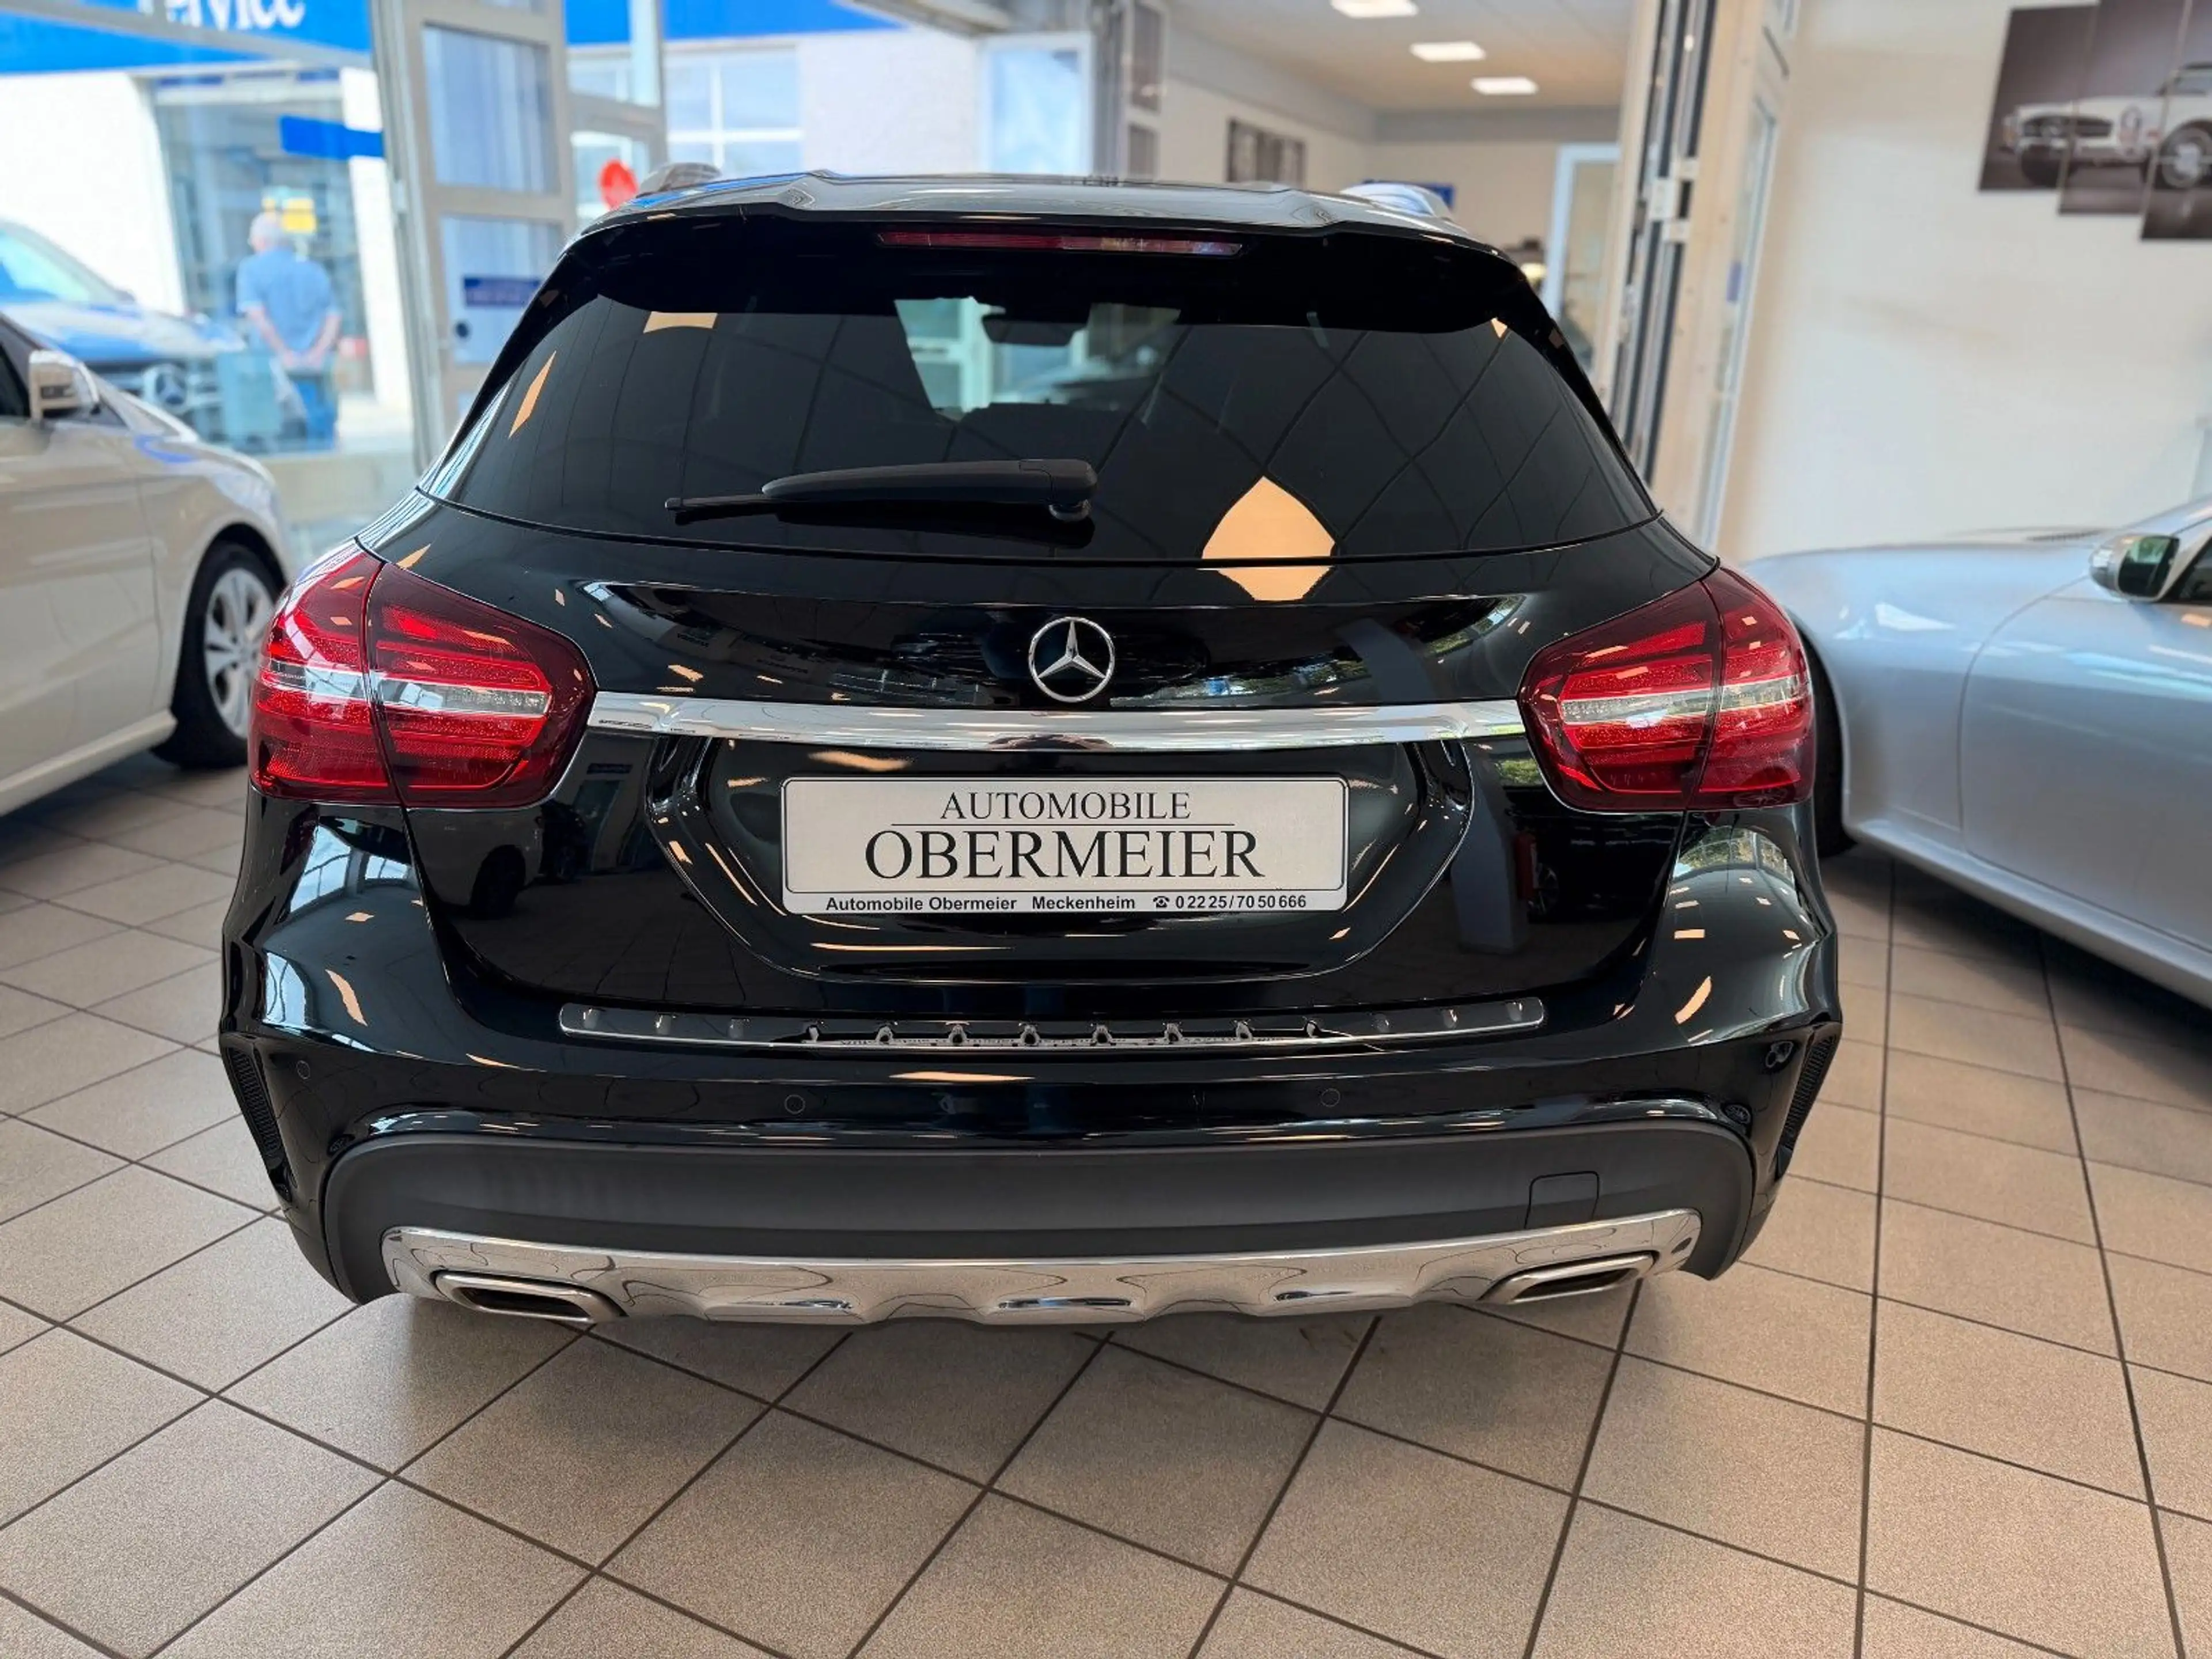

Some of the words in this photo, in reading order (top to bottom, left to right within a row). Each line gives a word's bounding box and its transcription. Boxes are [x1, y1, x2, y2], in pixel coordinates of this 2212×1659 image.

[940, 791, 1191, 820] AUTOMOBILE
[865, 830, 1266, 880] OBERMEIER
[825, 897, 922, 911] Automobile
[929, 896, 1017, 910] Obermeier
[1032, 895, 1135, 910] Meckenheim
